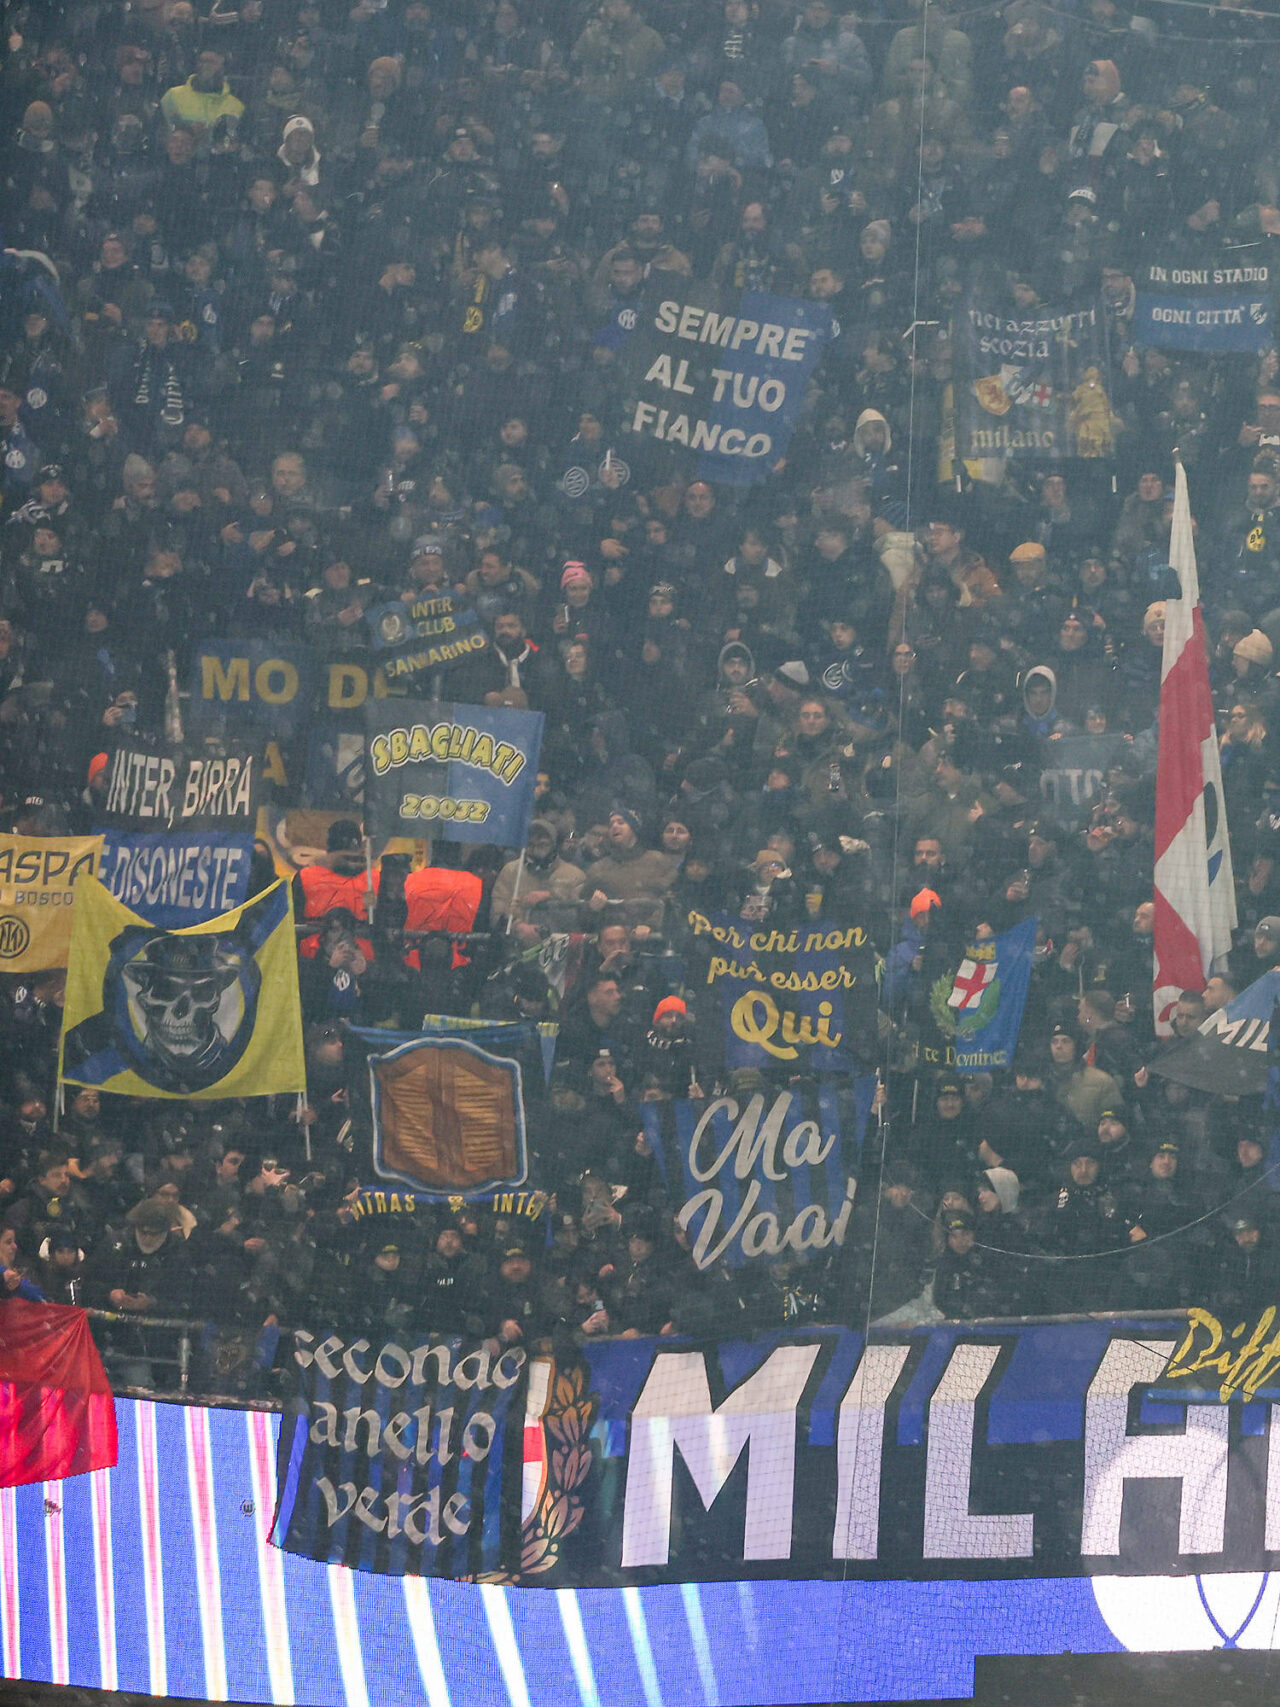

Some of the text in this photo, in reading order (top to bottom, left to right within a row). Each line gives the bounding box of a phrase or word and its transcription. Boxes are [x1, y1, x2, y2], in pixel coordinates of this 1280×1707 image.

[1150, 266, 1268, 285] IN OGNI STADIO
[655, 301, 811, 361] SEMPRE
[1152, 307, 1191, 324] OGNI
[980, 336, 1050, 359] scozia
[644, 354, 786, 412] AL TUO
[632, 401, 772, 457] FIANCO
[971, 425, 1055, 449] milano
[417, 616, 456, 637] CLUB
[371, 722, 528, 787] SBAGLIATI
[106, 749, 253, 829] INTER, BIRRA
[399, 793, 492, 824] 20032
[15, 890, 74, 906] BOSCO
[109, 845, 244, 911] DISONESTE
[688, 910, 745, 949] Per
[803, 925, 868, 952] non
[770, 964, 857, 992] esser
[730, 989, 842, 1060] Qui
[688, 1090, 837, 1183] Ma
[678, 1177, 858, 1270] Vaai
[309, 1401, 497, 1467] anello
[315, 1475, 472, 1547] verde
